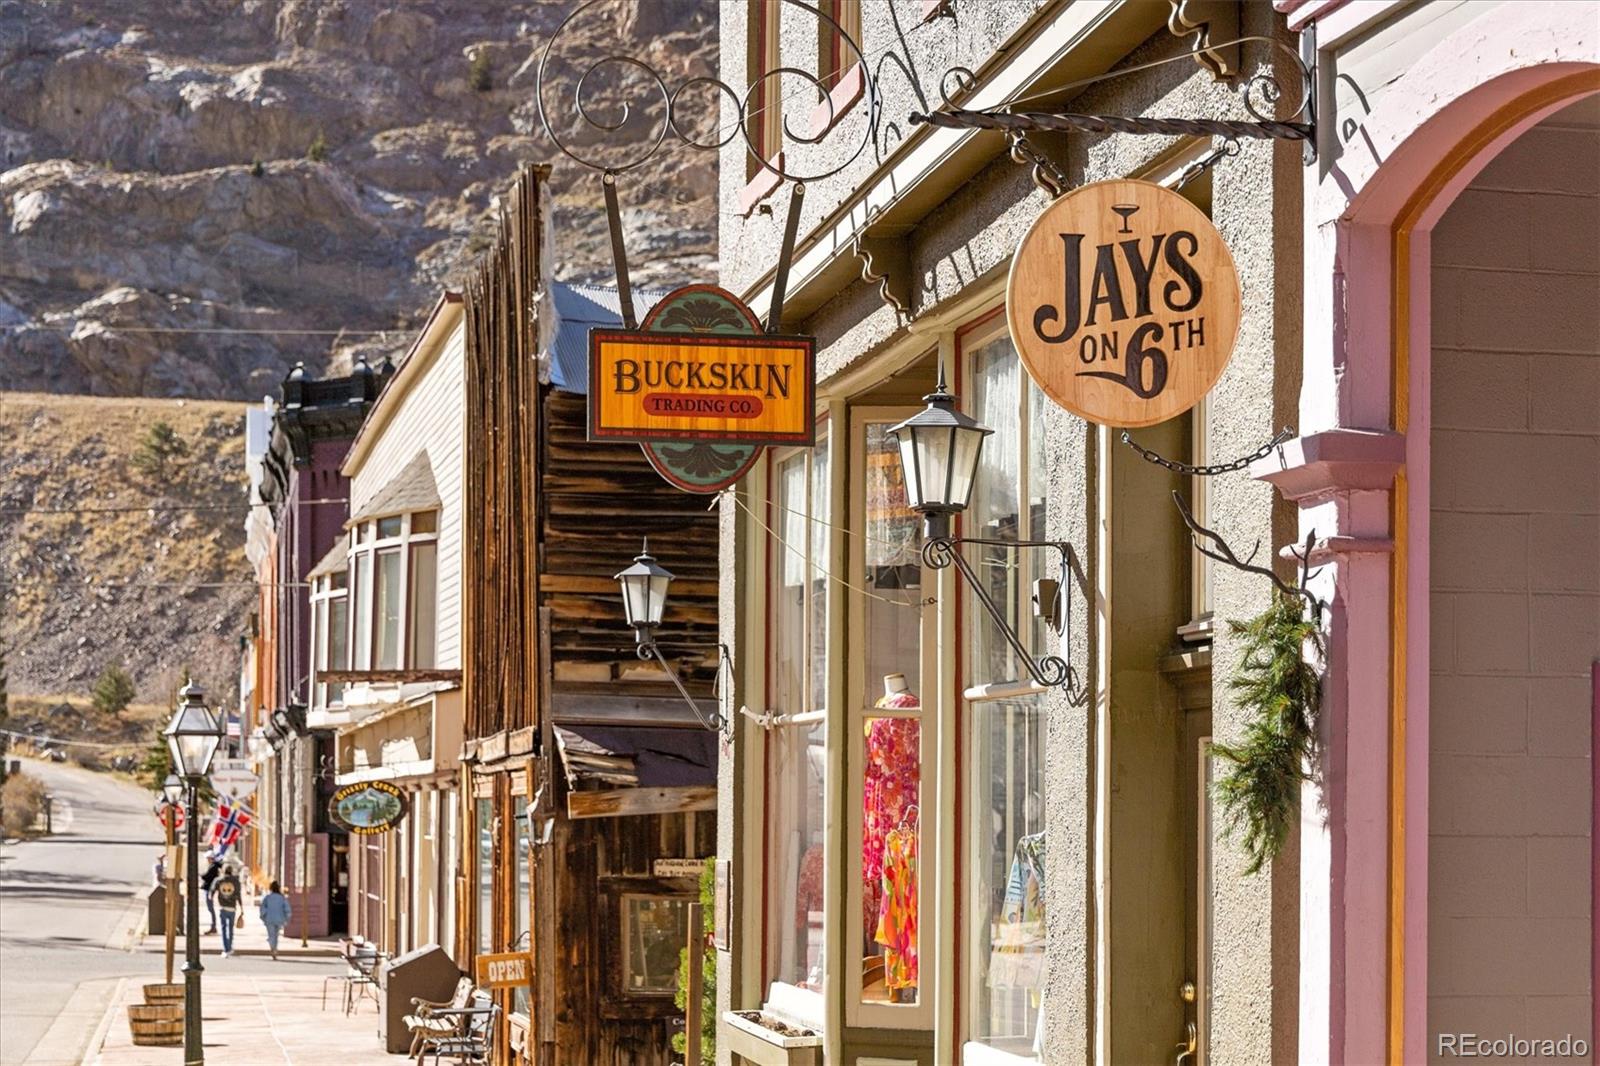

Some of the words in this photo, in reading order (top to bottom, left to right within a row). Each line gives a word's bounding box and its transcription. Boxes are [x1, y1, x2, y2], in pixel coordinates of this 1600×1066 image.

[1033, 230, 1203, 344] JAYS
[1079, 331, 1119, 364] ON
[1124, 317, 1205, 399] 6TH
[613, 359, 792, 399] BUCKSKIN
[652, 397, 725, 413] TRADING
[729, 400, 755, 414] CO.
[373, 781, 400, 796] Creek
[353, 823, 390, 835] Gallery
[487, 959, 526, 982] OPEN
